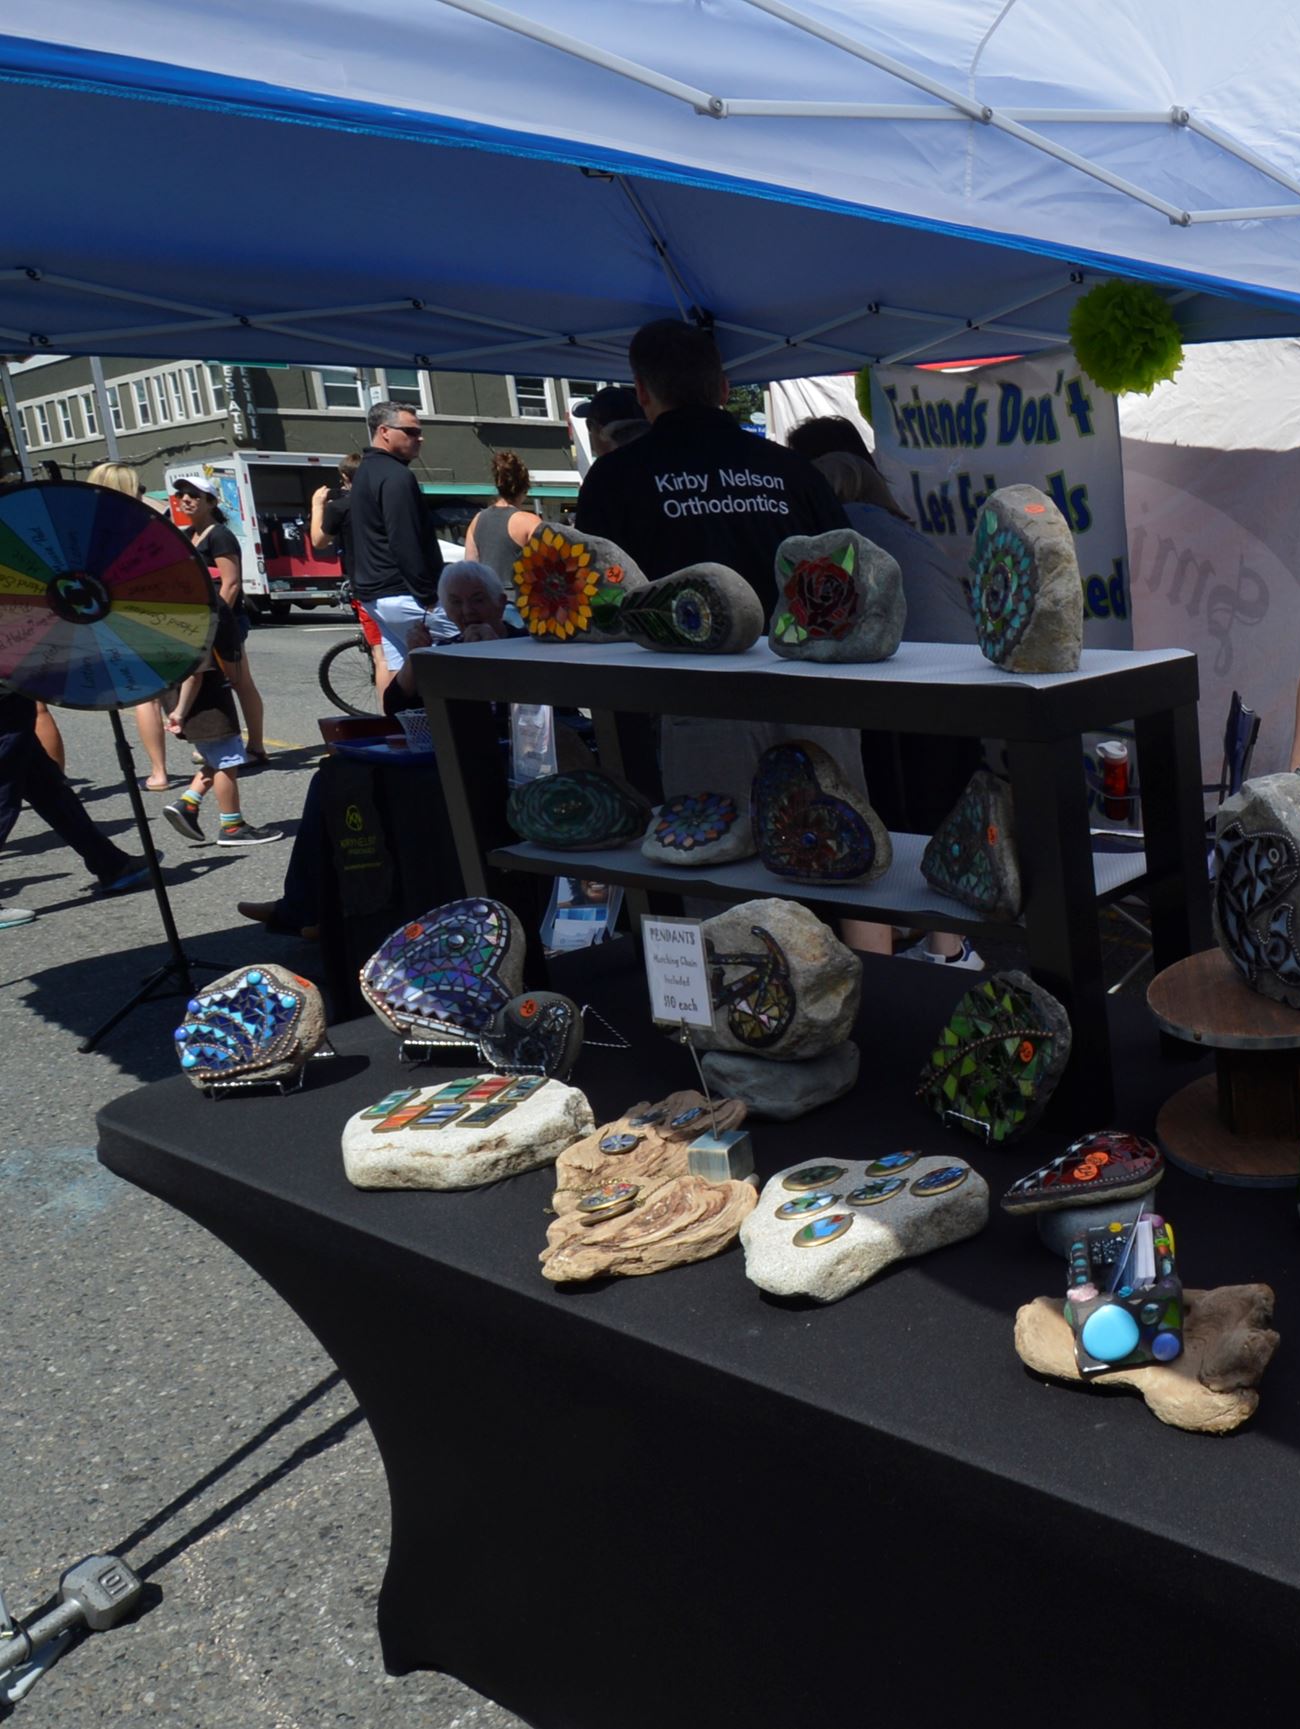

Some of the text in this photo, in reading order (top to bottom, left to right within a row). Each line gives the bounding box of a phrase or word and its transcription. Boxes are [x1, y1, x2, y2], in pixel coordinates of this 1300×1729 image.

[883, 369, 1095, 449] Friends Don't
[655, 469, 785, 492] Kirby Nelson
[663, 494, 789, 518] Orthodontics
[649, 927, 695, 945] PENDANTS
[679, 998, 698, 1012] each
